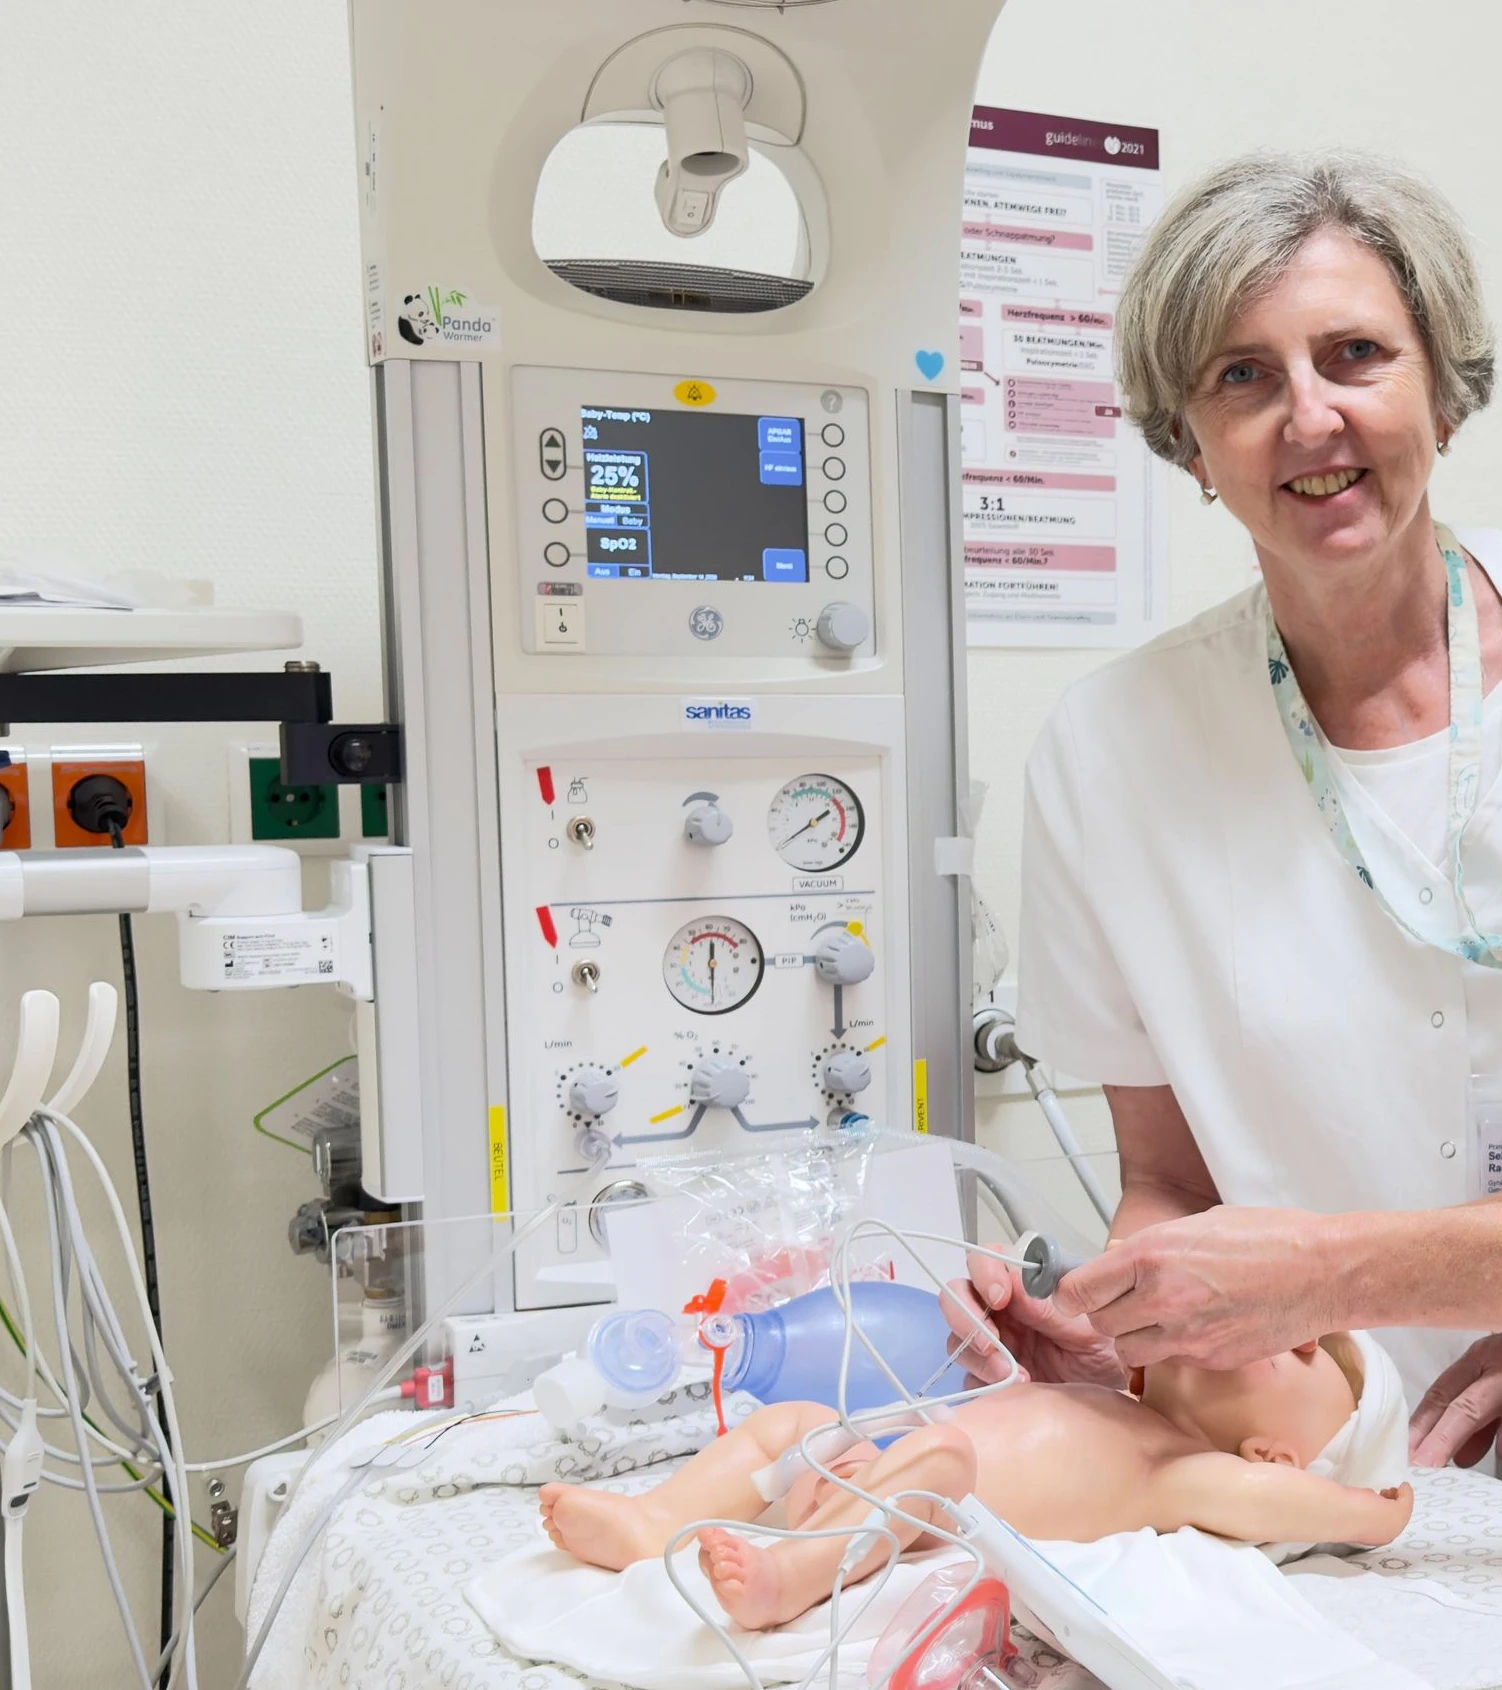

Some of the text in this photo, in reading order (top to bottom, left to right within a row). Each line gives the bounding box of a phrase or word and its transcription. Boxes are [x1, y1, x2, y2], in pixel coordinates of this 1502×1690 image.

[1121, 142, 1144, 155] 2021
[994, 201, 1042, 214] ATEMWEGE
[963, 226, 1056, 245] oder Schnappatmung?
[1007, 309, 1065, 322] Herzfrequenz
[443, 316, 491, 332] Panda
[444, 332, 483, 342] Warmer
[581, 408, 630, 421] Baby-Temp
[590, 464, 640, 487] 25%
[600, 504, 631, 514] Modus
[980, 496, 1004, 511] 3:1
[622, 516, 643, 526] Baby
[600, 537, 637, 552] SpO2
[595, 567, 641, 576] Aus Ein
[685, 701, 751, 719] sanitas
[799, 879, 837, 888] VACUUM
[790, 903, 806, 911] kPa
[781, 956, 797, 964] PIP
[849, 1019, 874, 1028] L/min
[544, 1040, 572, 1049] L/min
[493, 1142, 504, 1181] BEUTEL
